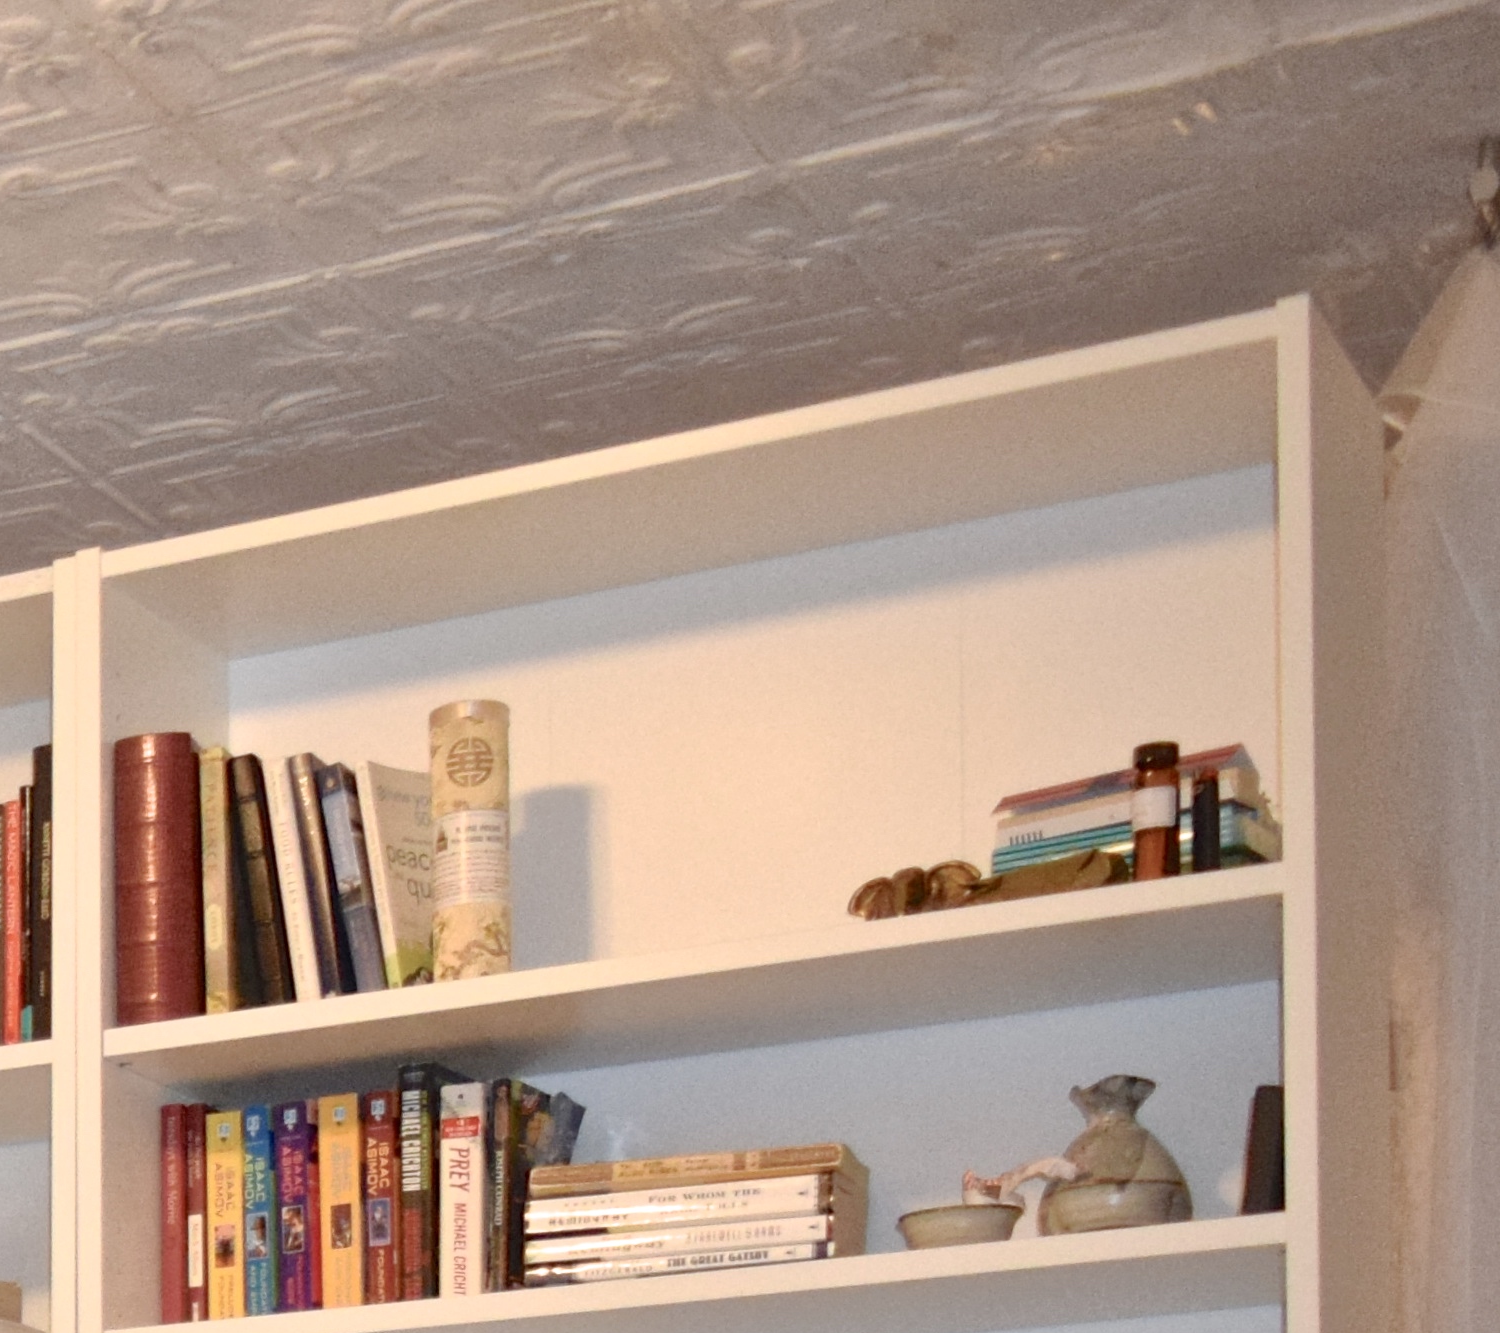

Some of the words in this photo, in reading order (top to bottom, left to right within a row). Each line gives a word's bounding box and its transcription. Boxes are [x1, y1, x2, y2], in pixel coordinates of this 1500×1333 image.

[6, 876, 17, 935] LANTERN
[401, 1090, 421, 1137] MICHAEL
[244, 1154, 255, 1210] ASIMOV
[255, 1157, 266, 1202] ISAAC
[366, 1137, 378, 1196] ASIMOV
[379, 1142, 390, 1189] ISAAC
[401, 1139, 421, 1192] CRICHTON
[448, 1146, 470, 1193] PREY
[214, 1162, 224, 1218] ASIMOV
[453, 1203, 467, 1252] MICHAEL
[453, 1255, 467, 1296] CRICHT
[667, 1256, 687, 1268] THE
[690, 1253, 725, 1266] GREAT
[728, 1250, 770, 1263] GATSBY
